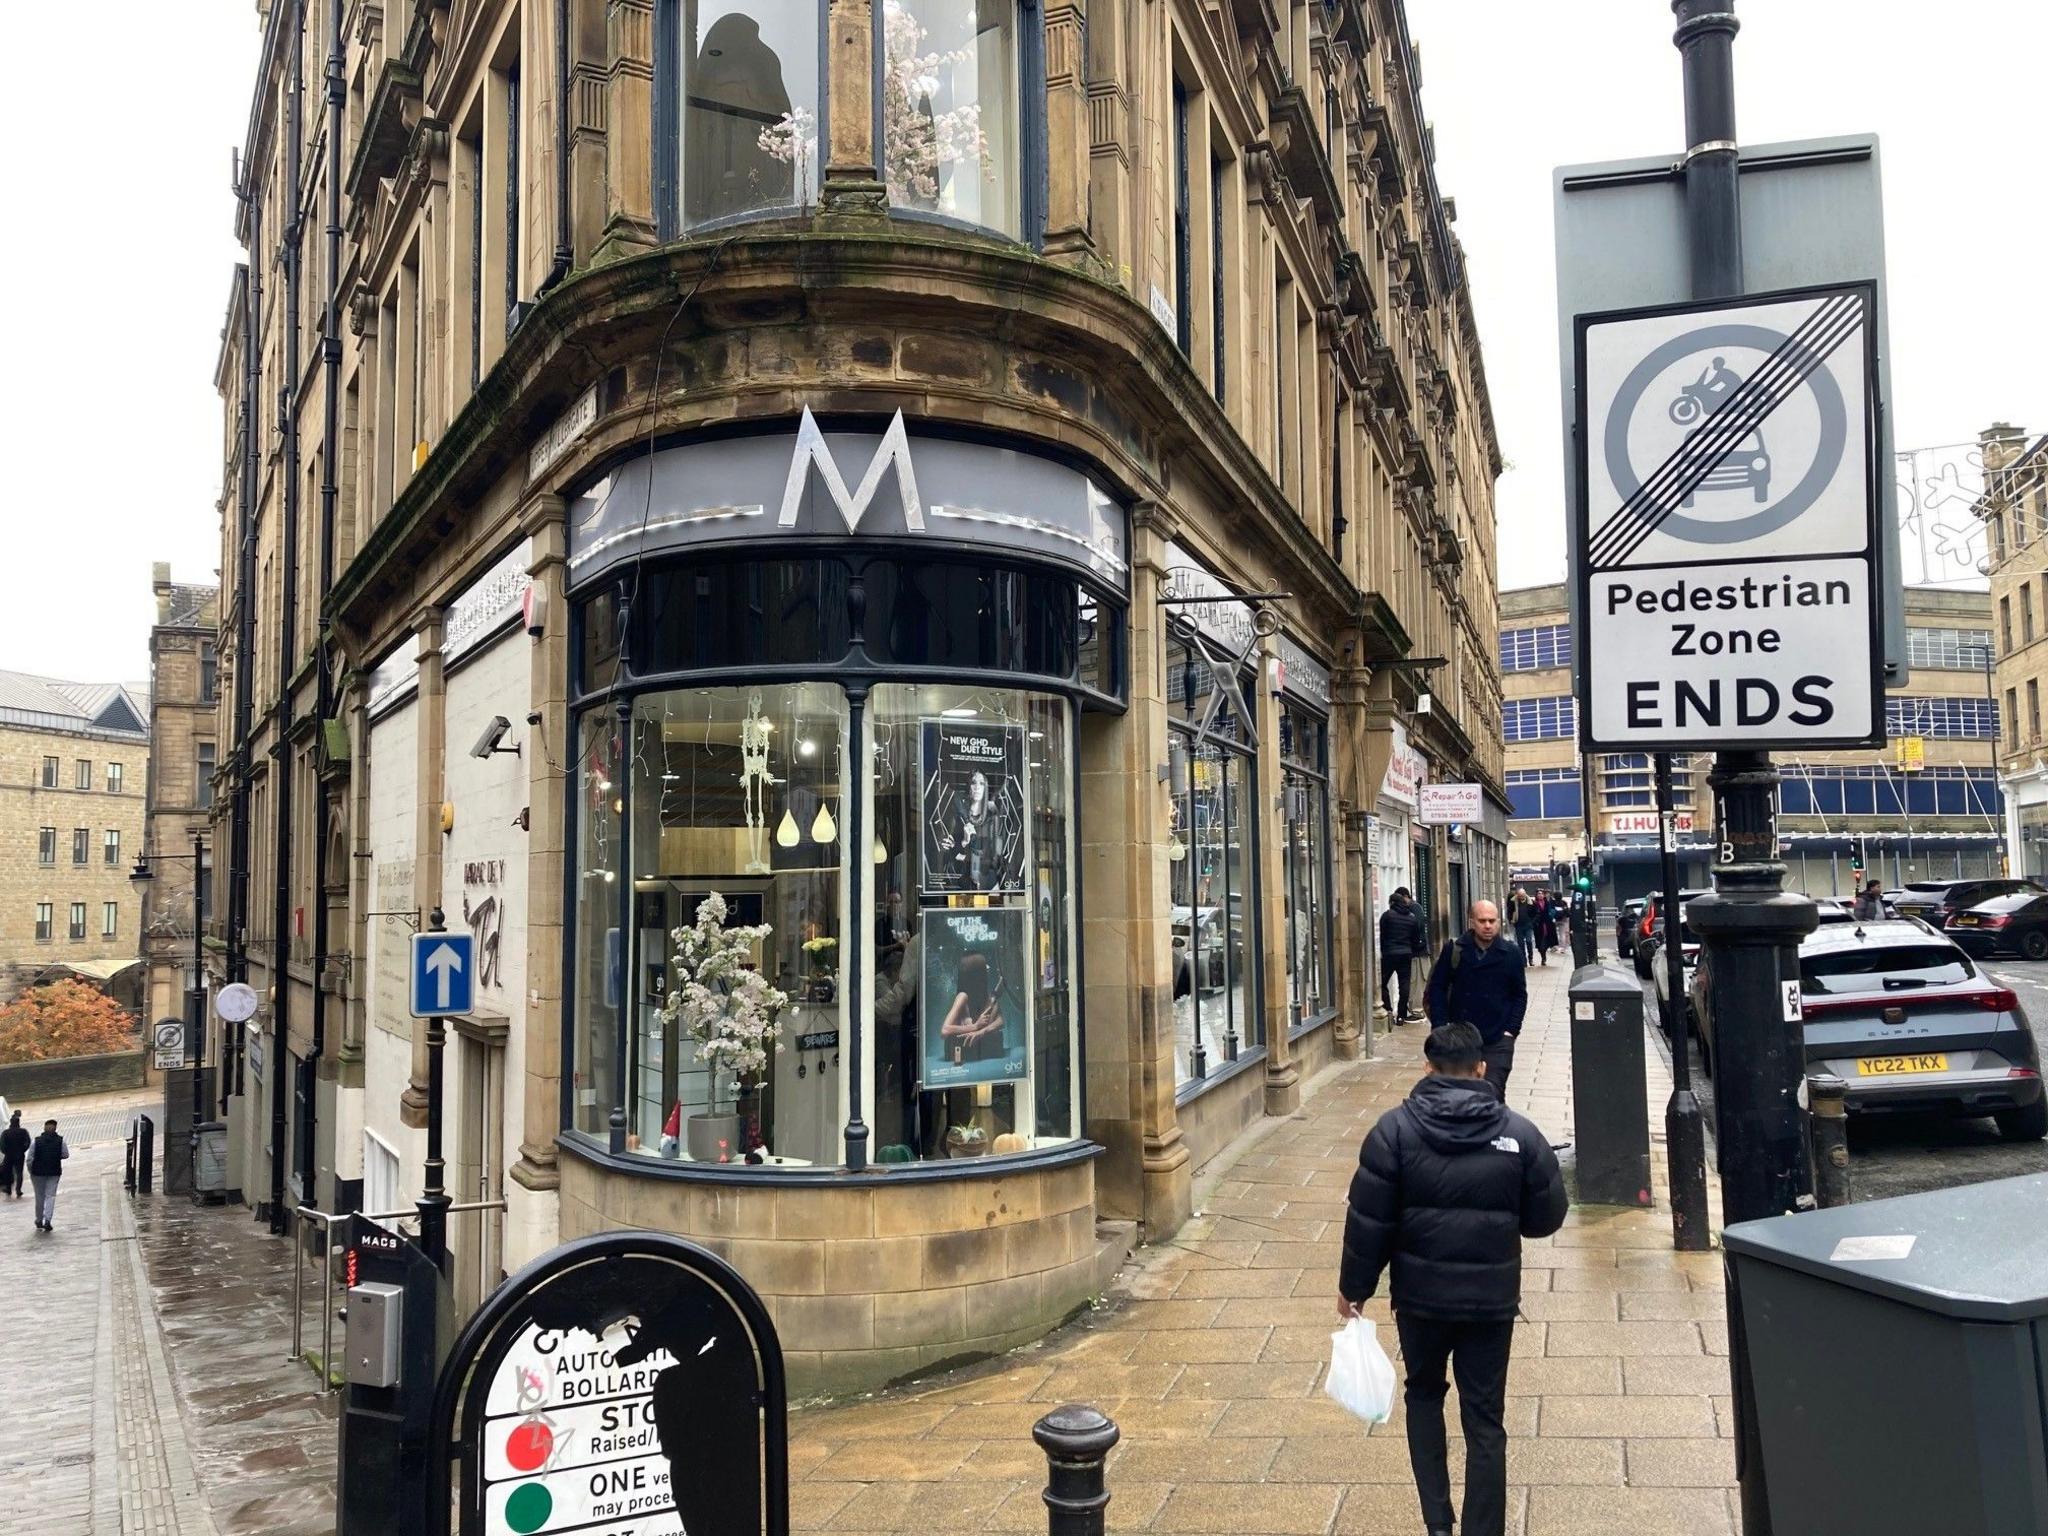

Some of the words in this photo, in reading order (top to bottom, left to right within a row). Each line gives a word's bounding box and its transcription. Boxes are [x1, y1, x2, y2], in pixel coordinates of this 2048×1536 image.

[778, 403, 926, 535] M
[1608, 574, 1850, 615] Pedestrian
[1671, 624, 1781, 656] Zone
[1626, 675, 1835, 729] ENDS
[950, 735, 968, 745] NEW
[970, 737, 988, 747] GHD
[961, 745, 980, 754] DUET
[981, 746, 1003, 756] STYLE
[1466, 791, 1478, 800] Go
[1004, 878, 1020, 890] ghd
[1575, 892, 1583, 901] P
[947, 916, 966, 927] GIFT
[966, 916, 982, 925] THE
[964, 932, 976, 942] OF
[978, 931, 998, 941] GHD
[1004, 1059, 1023, 1073] ghd
[1863, 1058, 1906, 1073] YC22
[1908, 1055, 1941, 1071] TKX
[361, 1235, 397, 1249] MACS
[589, 1466, 646, 1497] ONE
[592, 1501, 623, 1518] may
